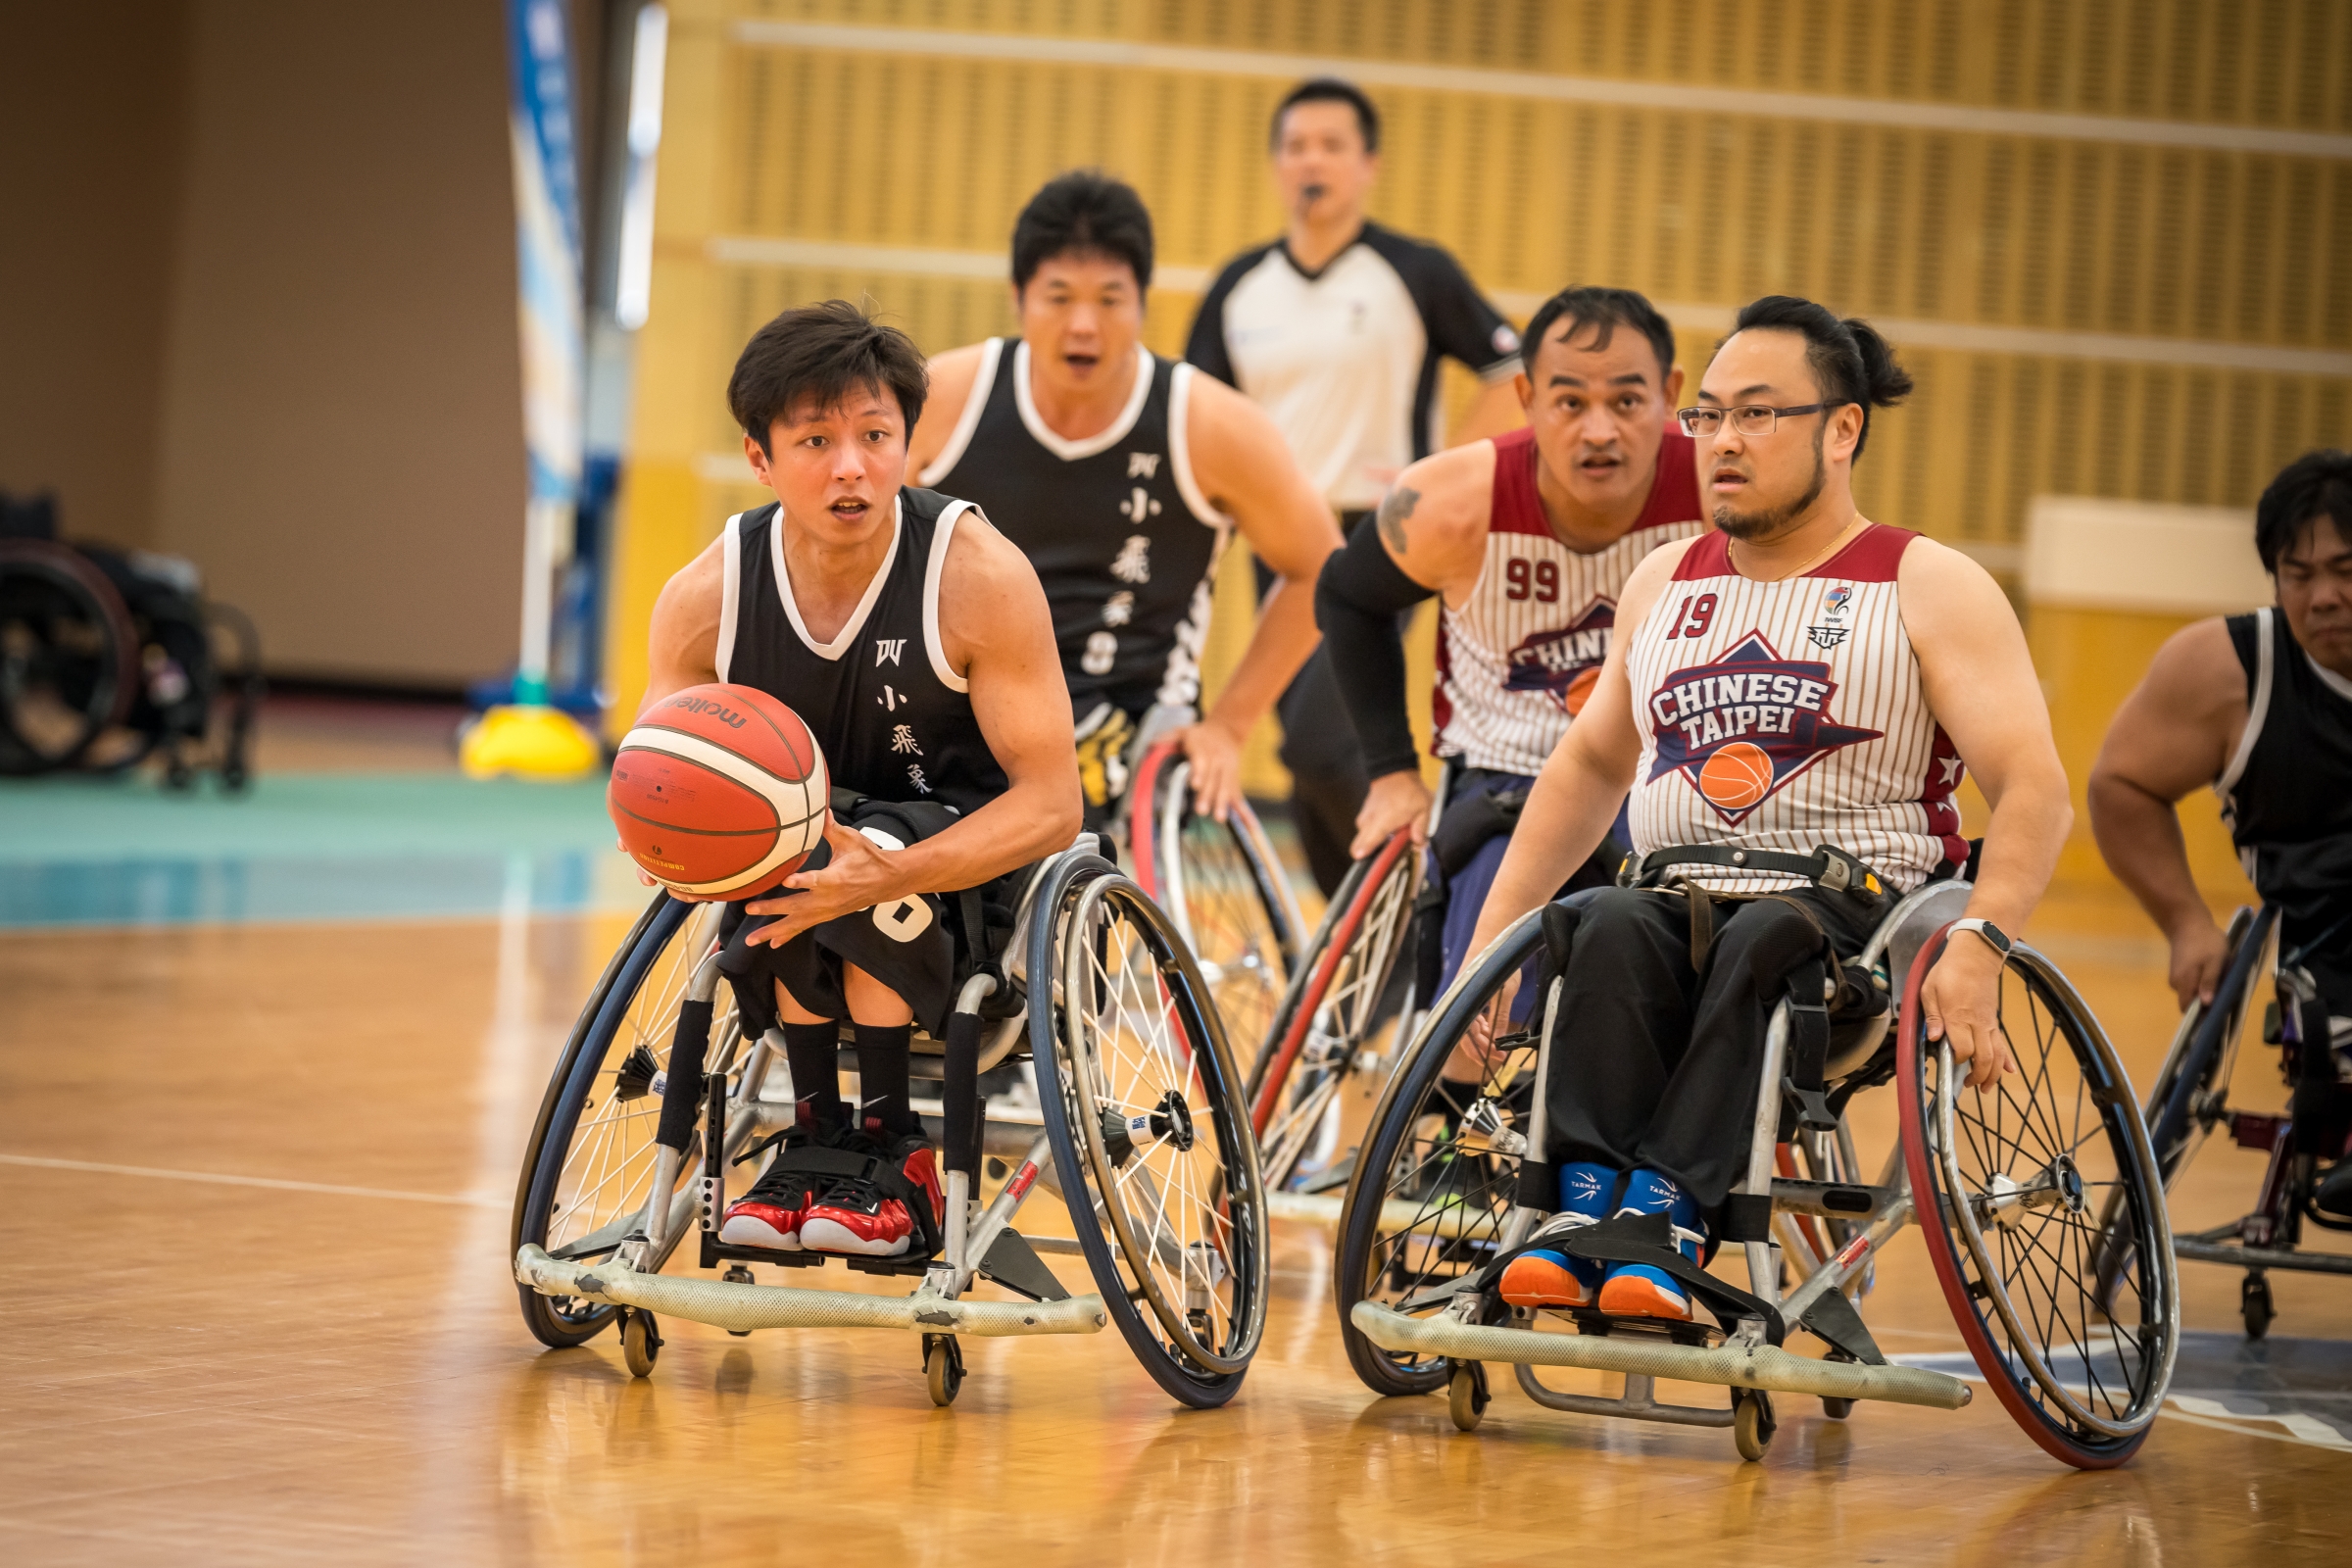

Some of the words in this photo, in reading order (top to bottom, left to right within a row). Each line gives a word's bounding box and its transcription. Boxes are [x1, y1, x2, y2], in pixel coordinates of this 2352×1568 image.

[1506, 558, 1559, 603] 99
[1666, 593, 1718, 640] 19
[664, 696, 748, 729] molten
[1652, 673, 1829, 726] CHINESE
[877, 685, 933, 795] 小飛象
[1680, 705, 1795, 751] TAIPEI
[640, 853, 685, 871] COMPETITION
[1571, 1181, 1602, 1191] TARMAK
[1649, 1185, 1682, 1201] TARMAK
